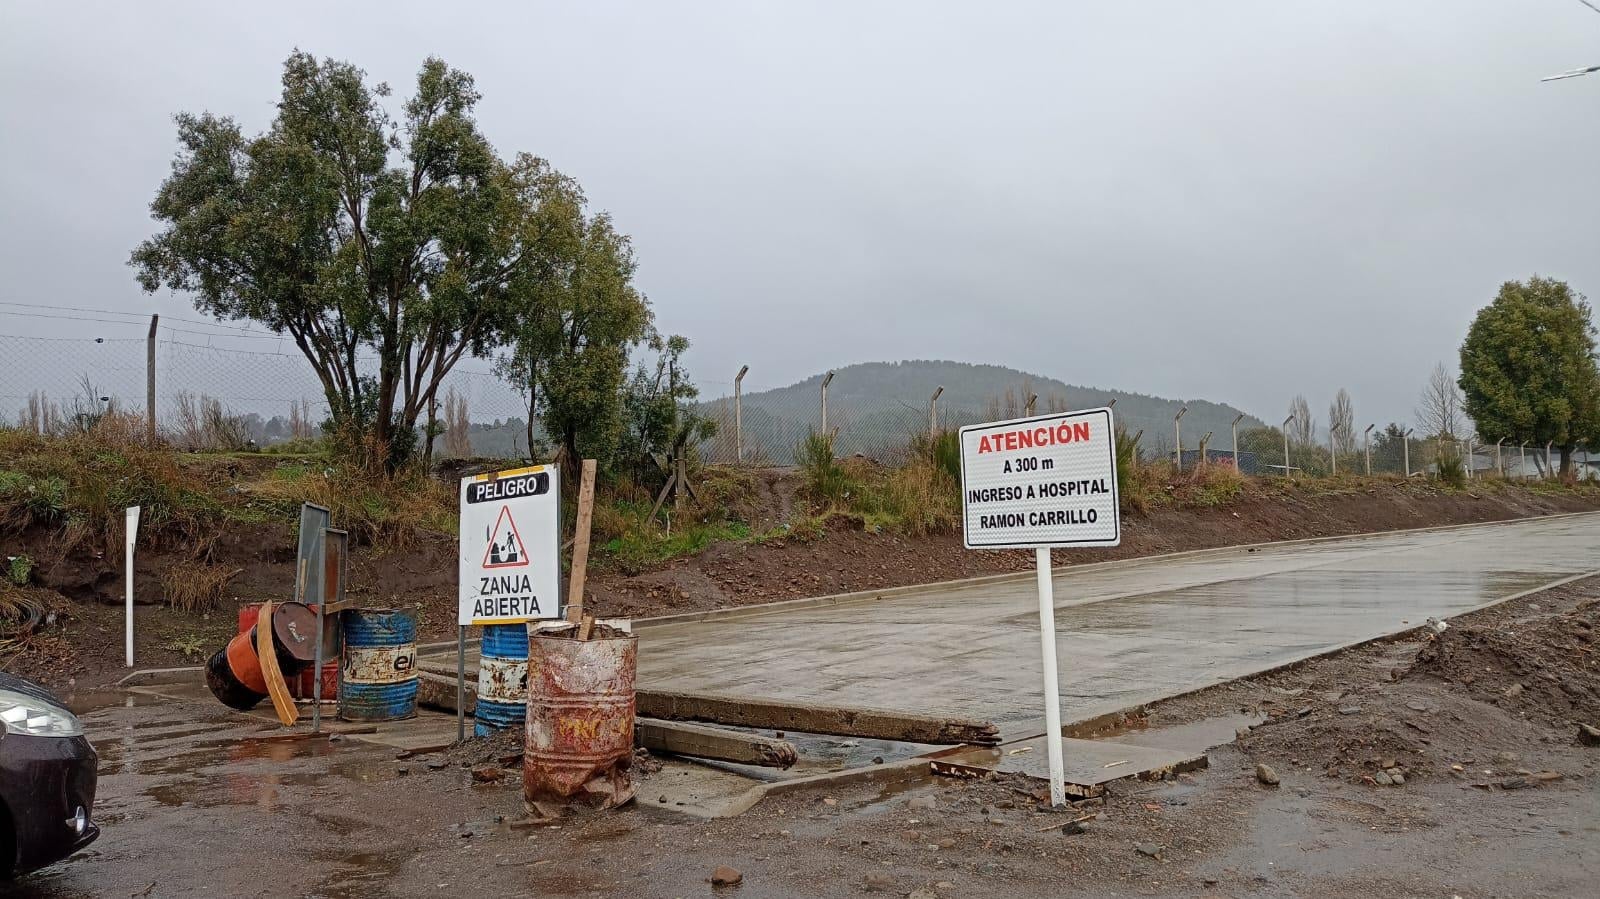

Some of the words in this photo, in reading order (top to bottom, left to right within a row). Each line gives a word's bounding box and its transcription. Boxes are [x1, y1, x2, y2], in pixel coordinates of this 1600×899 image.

[978, 420, 1090, 454] ATENCIÓN
[1003, 460, 1012, 474] A
[1015, 456, 1038, 473] 300
[1041, 458, 1054, 470] m
[476, 476, 537, 500] PELIGRO
[968, 486, 1023, 504] INGRESO
[1026, 485, 1036, 499] A
[1039, 478, 1109, 498] HOSPITAL
[980, 513, 1026, 529] RAMON
[1029, 508, 1098, 527] CARRILLO
[480, 575, 532, 596] ZANJA
[473, 596, 541, 617] ABIERTA
